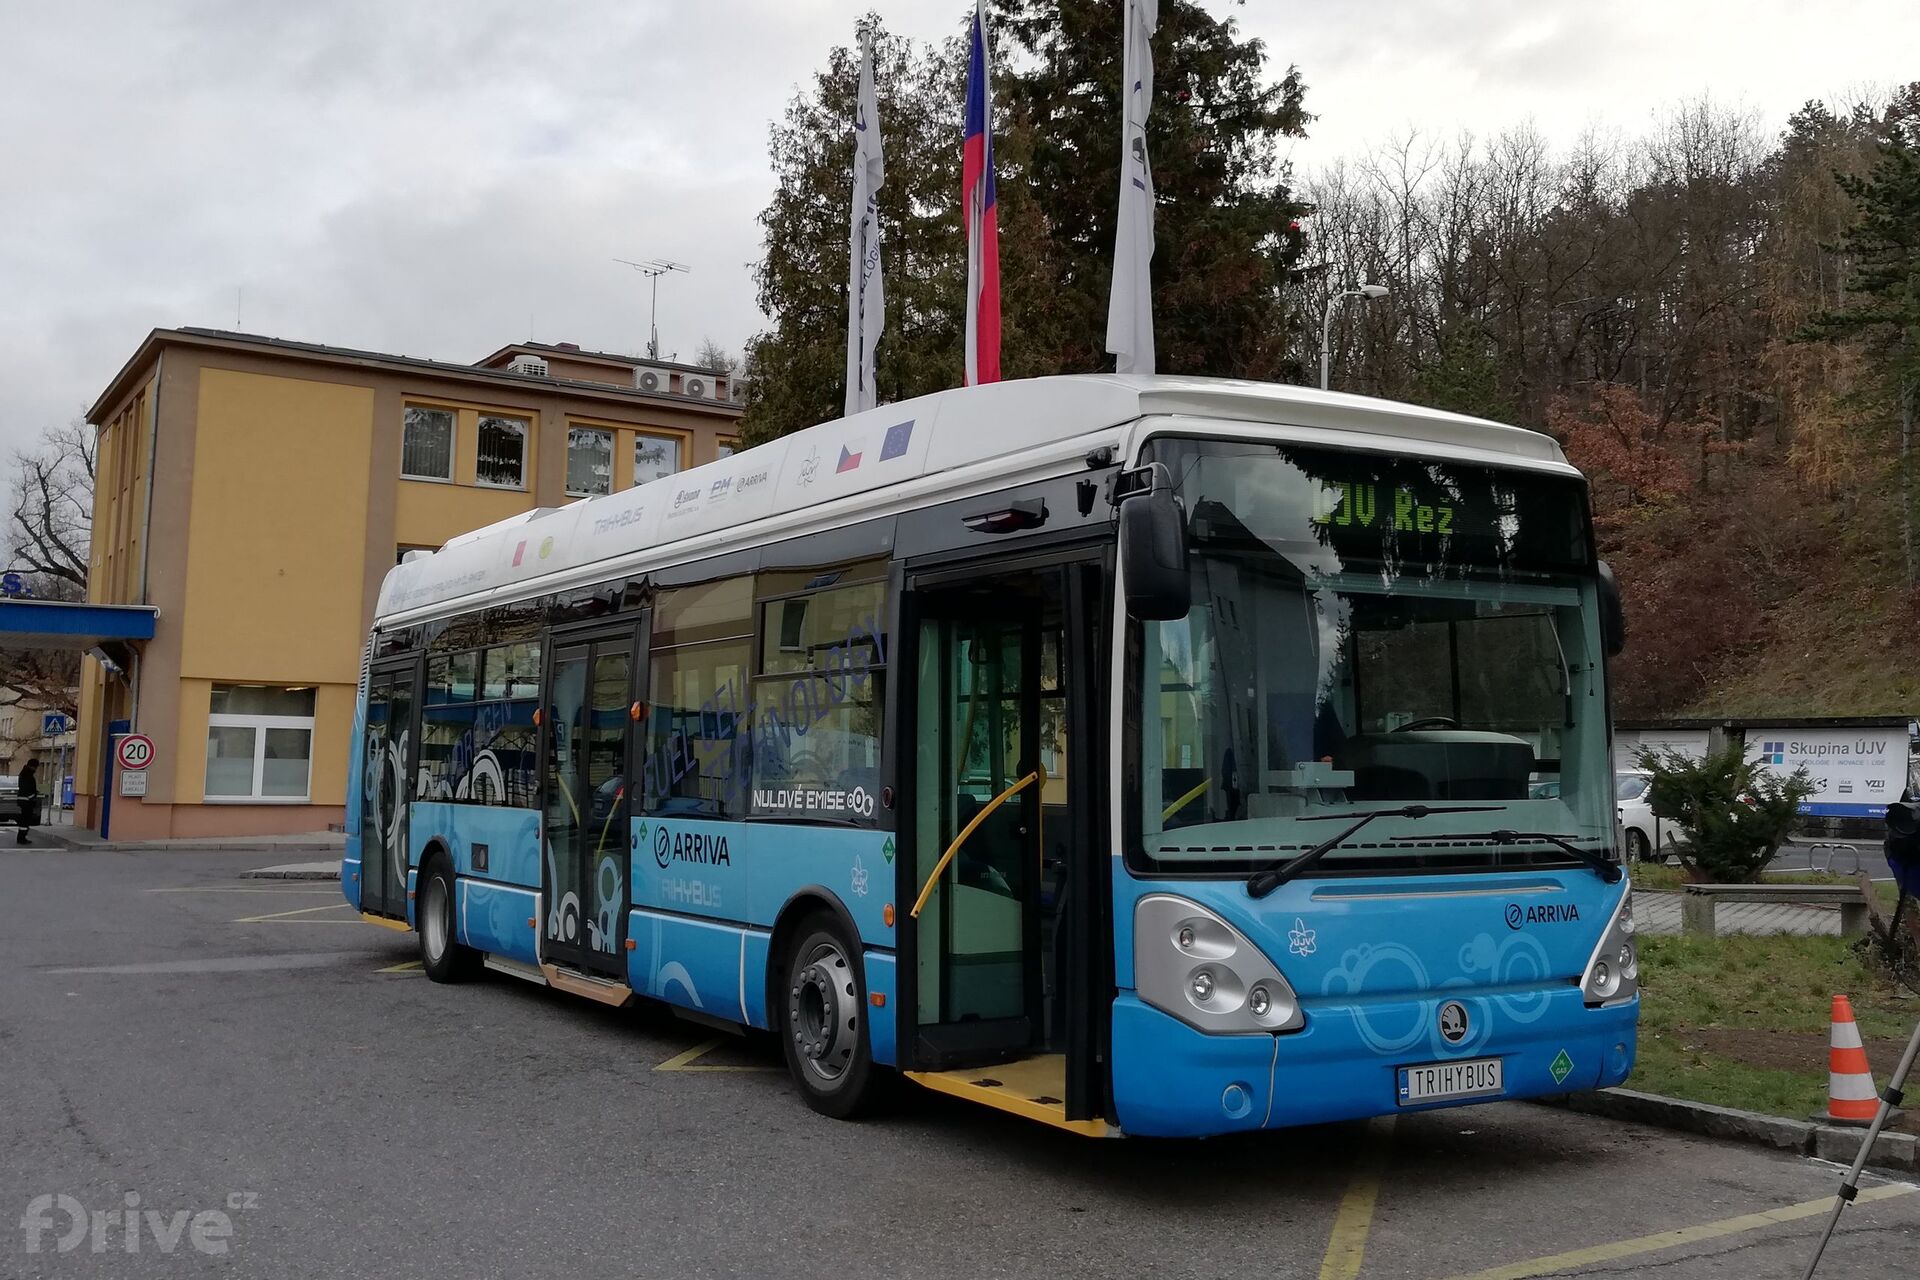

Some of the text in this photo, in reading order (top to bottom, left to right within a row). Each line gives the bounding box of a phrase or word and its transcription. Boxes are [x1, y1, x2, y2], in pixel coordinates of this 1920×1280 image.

[125, 743, 147, 760] 20
[1789, 738, 1887, 757] Skupina ÚJV
[753, 784, 846, 810] NULOVÉ EMISE
[673, 832, 730, 867] ARRIVA
[657, 875, 722, 908] RIHYBUS
[1526, 902, 1580, 924] ARRIVA
[1415, 1063, 1496, 1095] TRIHYBUS
